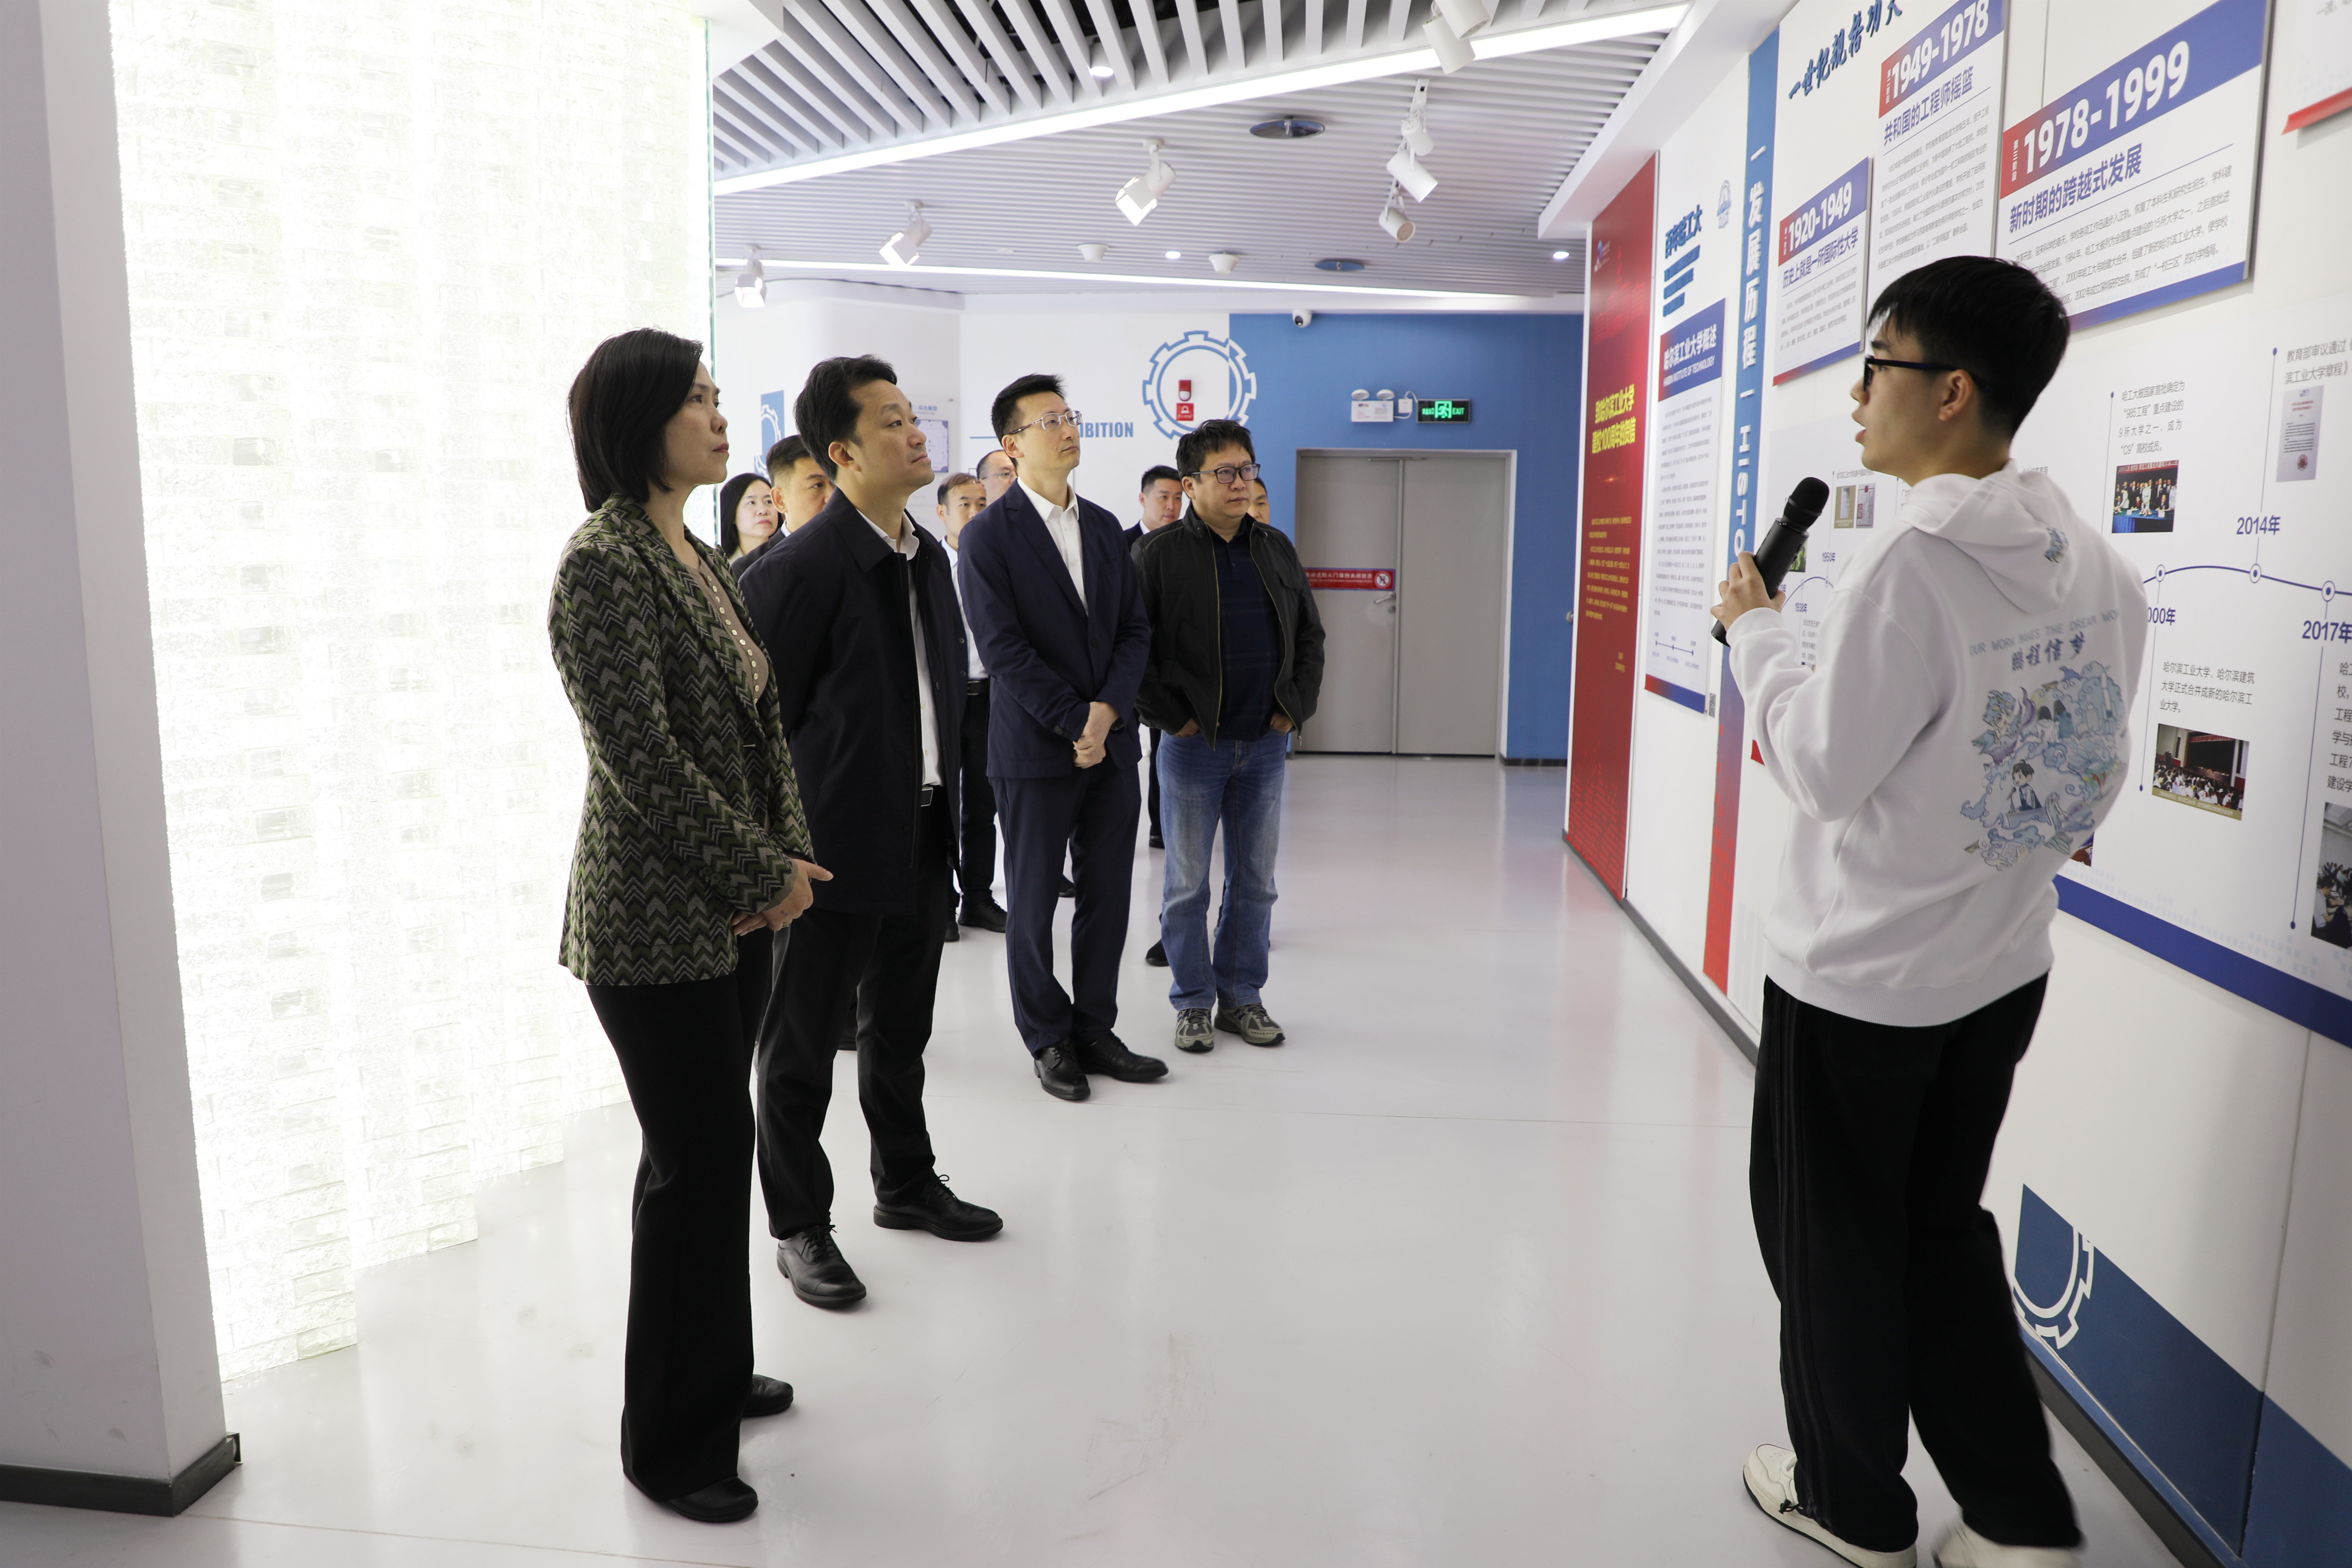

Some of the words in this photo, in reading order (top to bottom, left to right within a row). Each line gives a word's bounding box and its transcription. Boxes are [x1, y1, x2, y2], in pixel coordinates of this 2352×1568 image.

[1891, 0, 1989, 100] 1949-1978
[1884, 65, 1974, 146] 共和国的工程师摇篮
[2024, 40, 2189, 174] 1978-1999
[2009, 142, 2143, 234] 新时期的跨越式发展
[1788, 181, 1853, 252] 1920-1949
[1664, 323, 1717, 370] 哈尔滨工业大学概述
[2122, 379, 2185, 401] 哈工大被国家首批确定为
[2236, 515, 2281, 535] 2014年
[2302, 620, 2352, 644] 2017年
[1969, 642, 1986, 656] OUR
[1991, 637, 2015, 651] WORK
[2163, 661, 2255, 684] 哈尔滨工业大学、哈尔滨建筑
[2161, 680, 2253, 705] 大学正式合并成新的哈尔滨工
[2159, 699, 2181, 713] 业大学。
[2332, 730, 2352, 746] 学与
